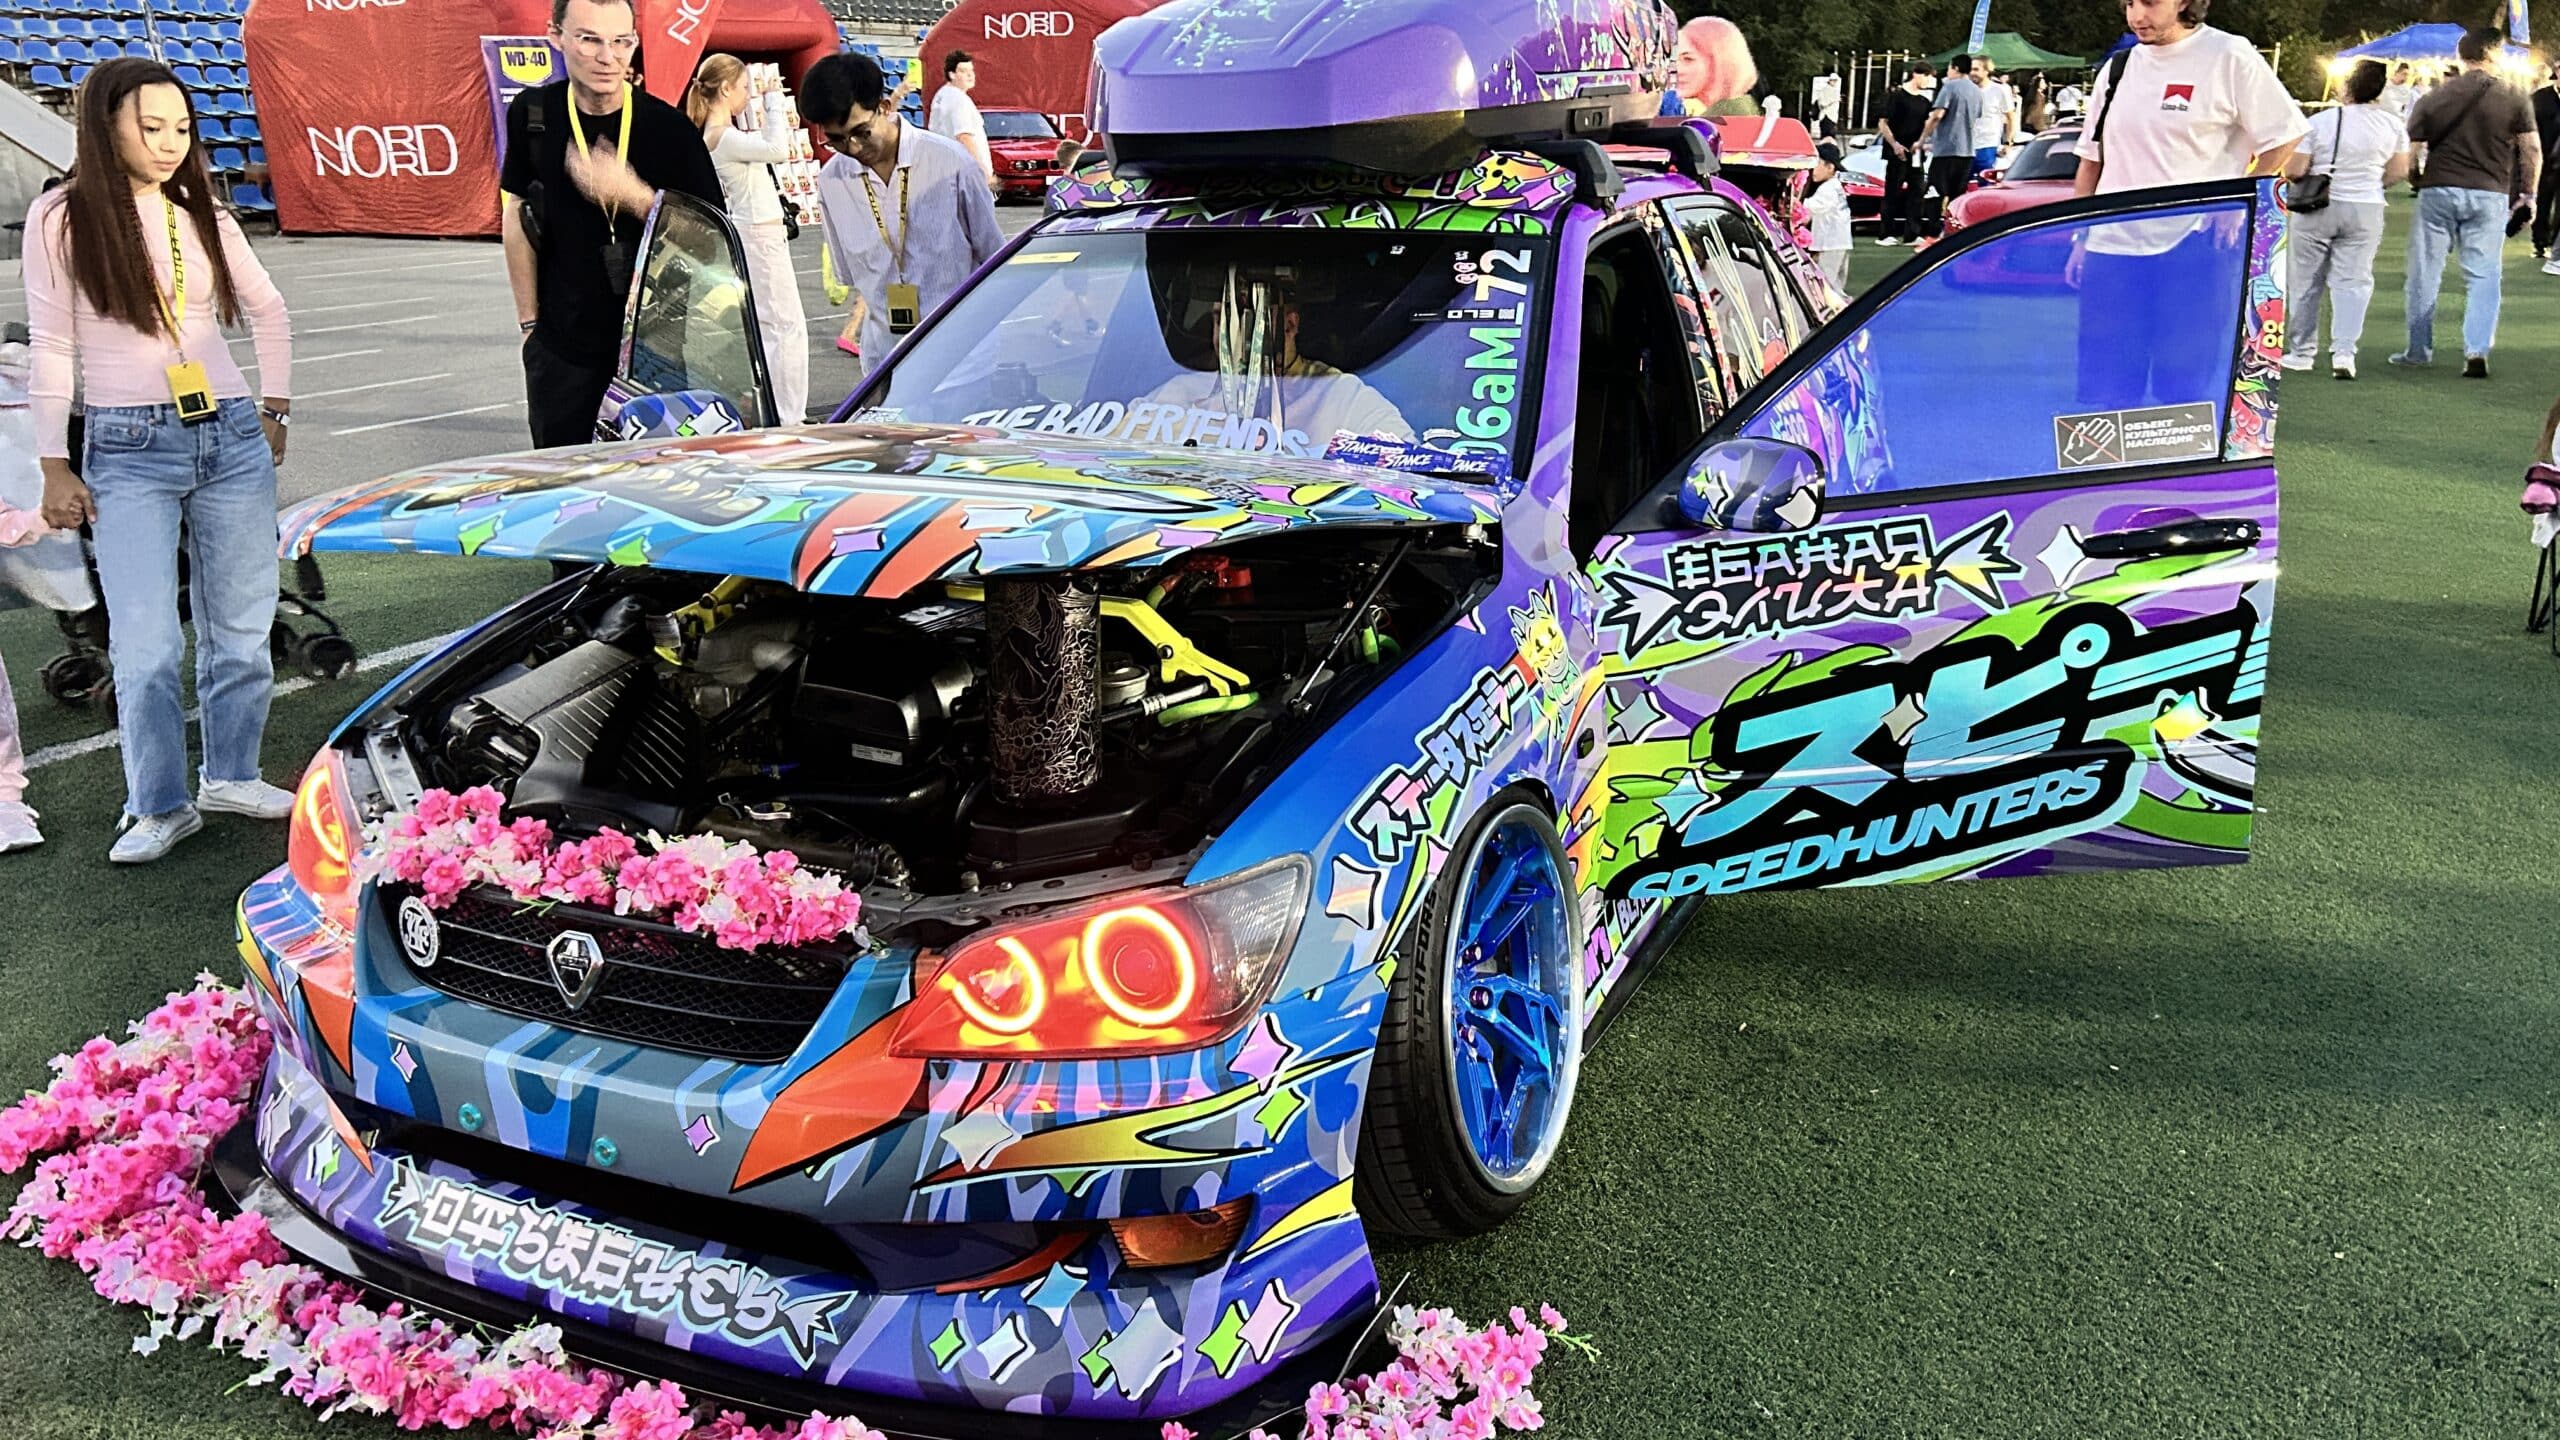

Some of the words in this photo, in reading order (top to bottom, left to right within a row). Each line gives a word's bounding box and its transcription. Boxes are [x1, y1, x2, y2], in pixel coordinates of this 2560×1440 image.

[983, 11, 1074, 39] NORD
[308, 124, 458, 178] NORD
[1034, 400, 1127, 438] BAD
[1121, 402, 1311, 458] FRIENDS
[2124, 418, 2175, 431] ОБЪЕКТ
[2124, 423, 2213, 440] КУЛЬТУРНОГО
[1336, 438, 1381, 455] STANCE
[2125, 434, 2194, 449] НАСЛЕДИЯ
[1383, 453, 1433, 468] STANCE
[1628, 759, 2108, 900] SPEEDHUNTERS
